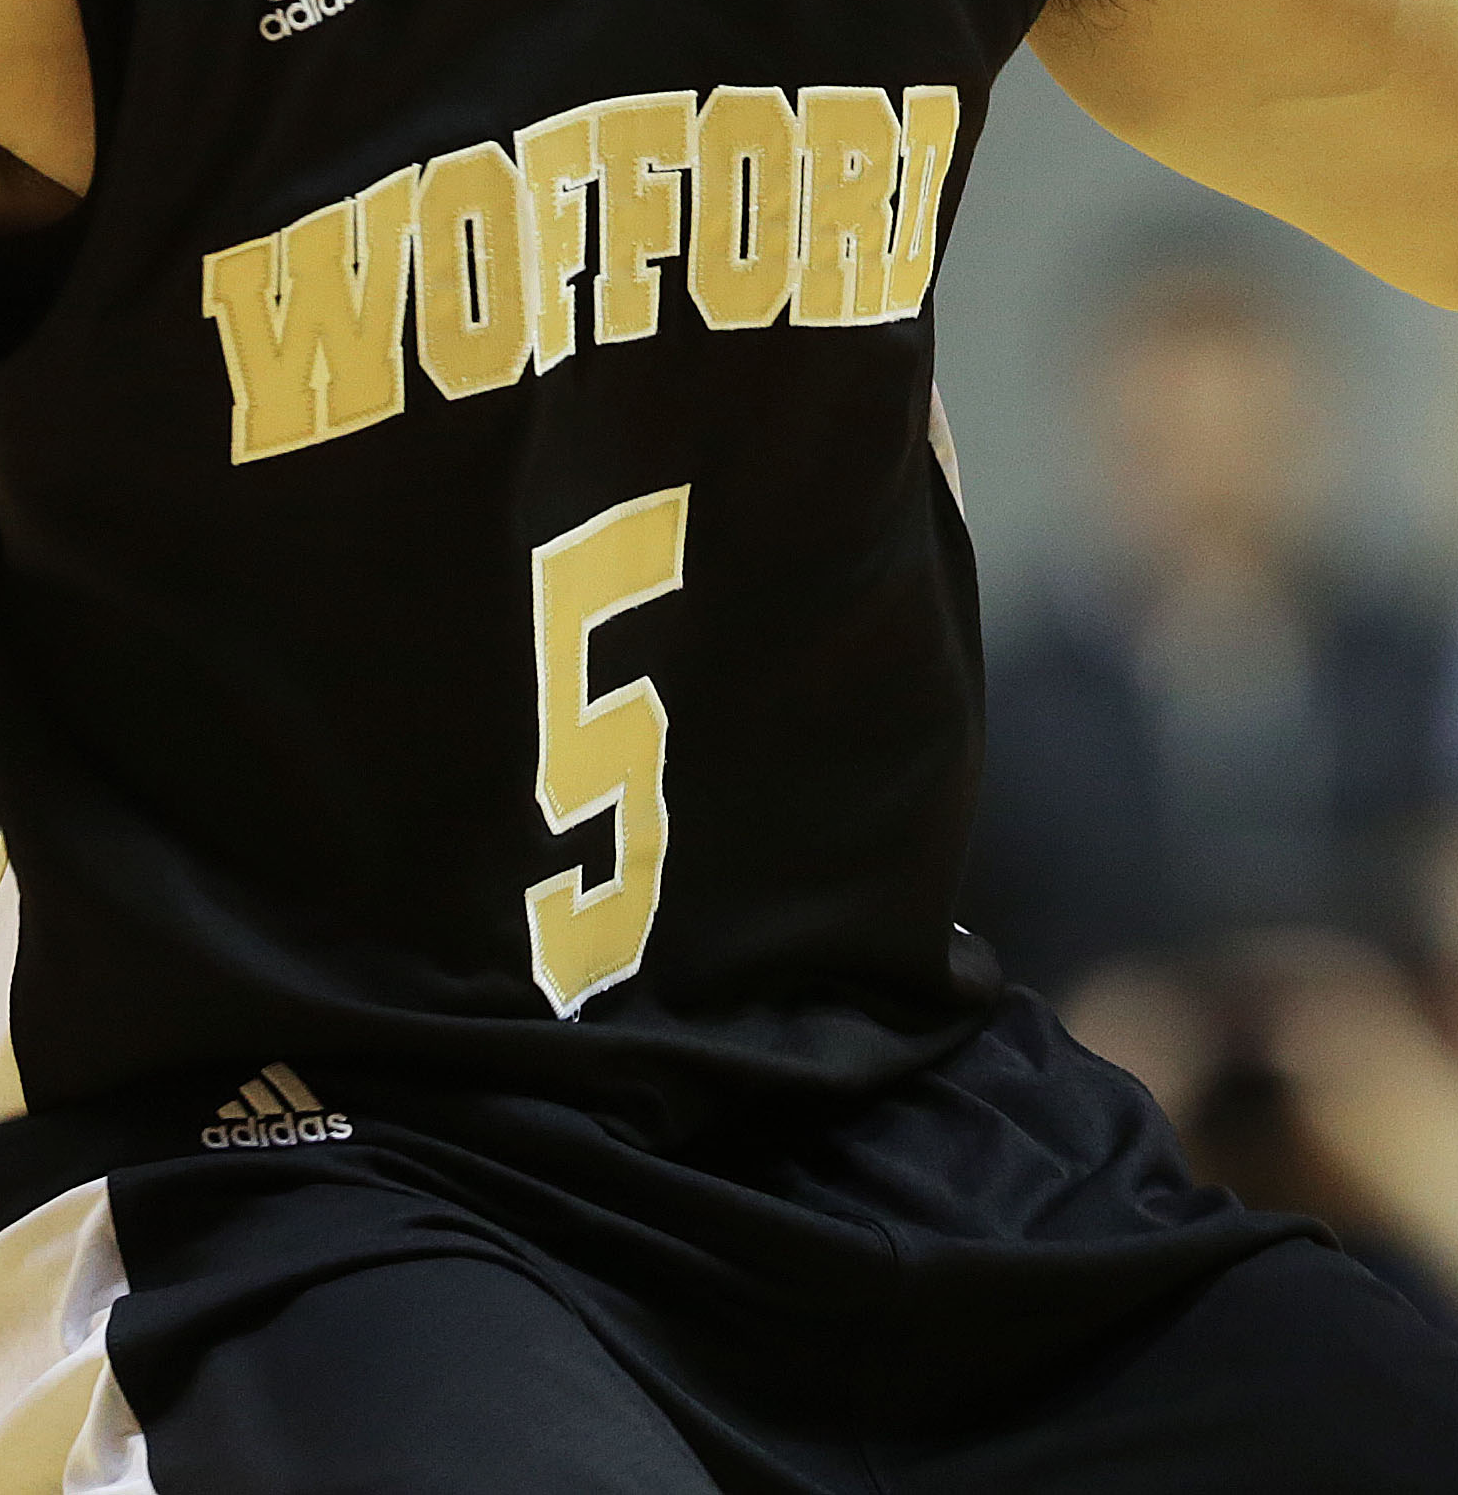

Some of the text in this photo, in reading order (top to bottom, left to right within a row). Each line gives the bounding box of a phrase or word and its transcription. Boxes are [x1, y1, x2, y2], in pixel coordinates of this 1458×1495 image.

[203, 85, 960, 465] WOFFORD
[525, 483, 691, 1020] 5
[202, 1112, 353, 1149] adidas
